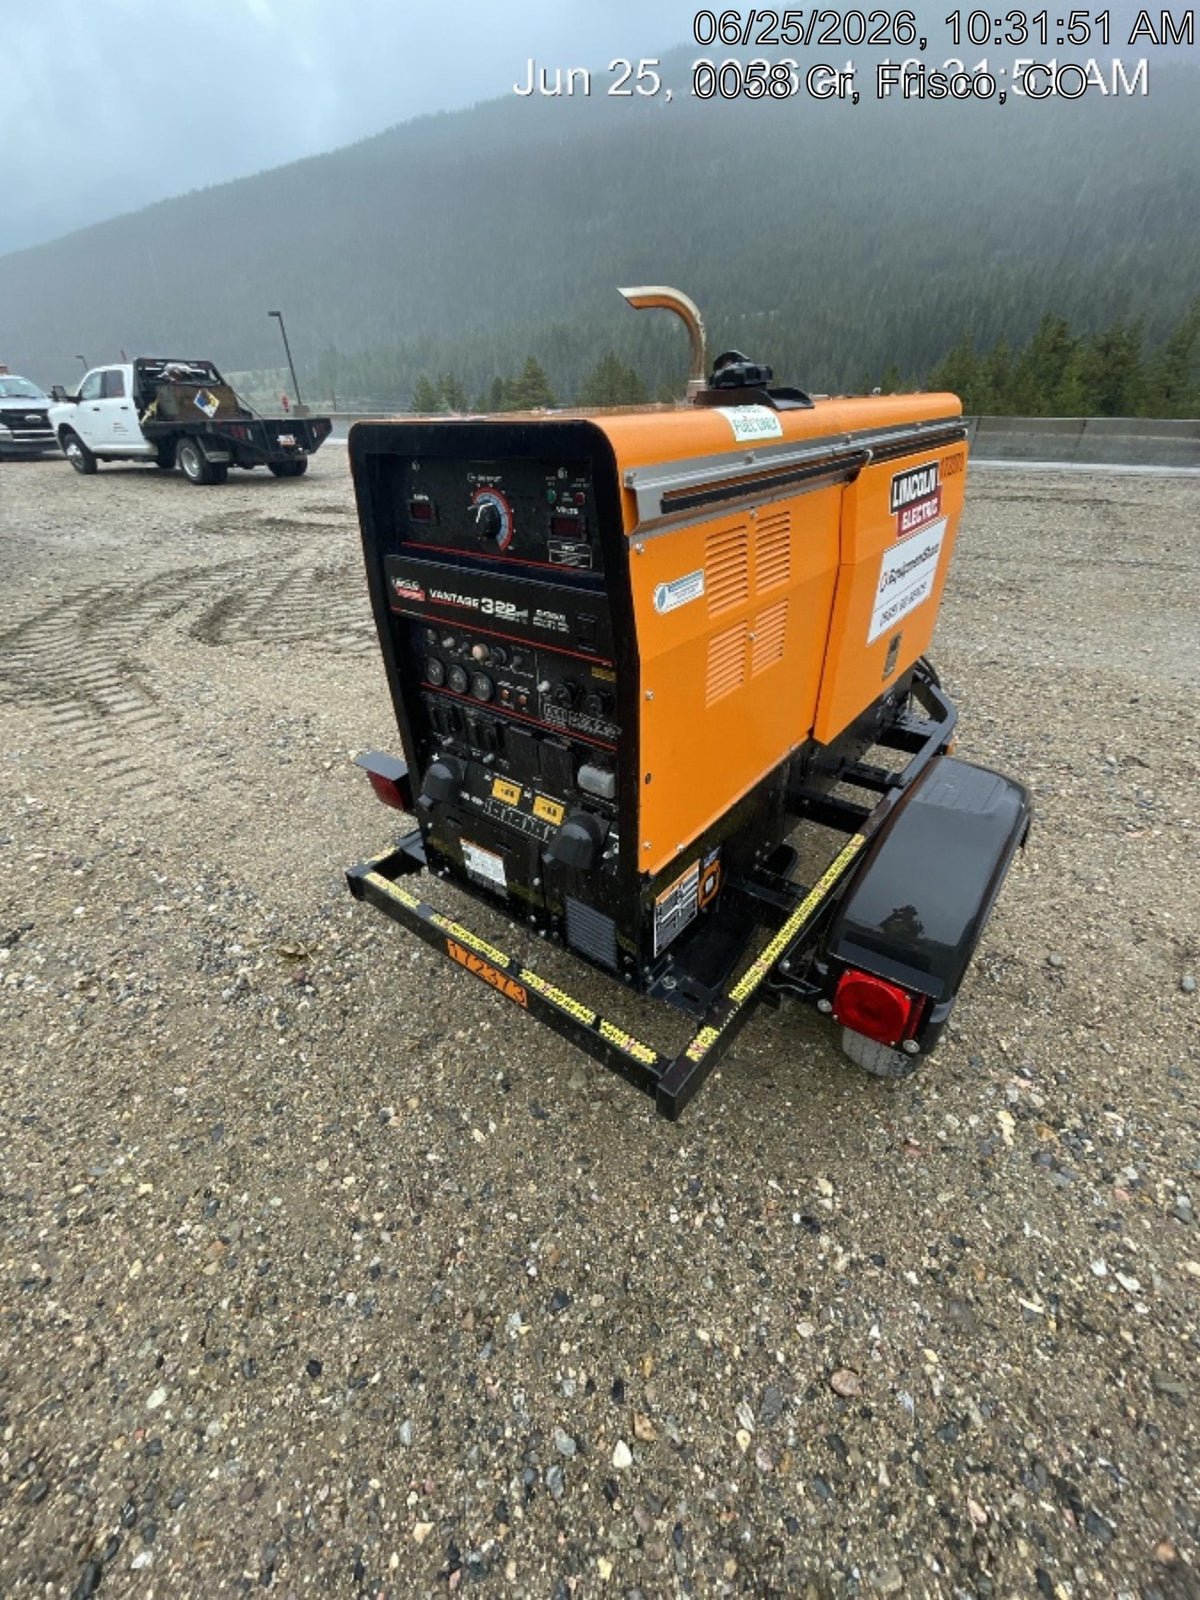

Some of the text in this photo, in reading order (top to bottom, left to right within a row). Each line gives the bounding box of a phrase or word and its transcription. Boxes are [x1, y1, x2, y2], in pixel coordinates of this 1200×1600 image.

[892, 466, 937, 509] LINCOLN
[901, 497, 939, 531] ELECTRIC
[429, 589, 480, 609] VANTAGE
[480, 597, 517, 616] 322
[449, 941, 527, 1006] 172373
